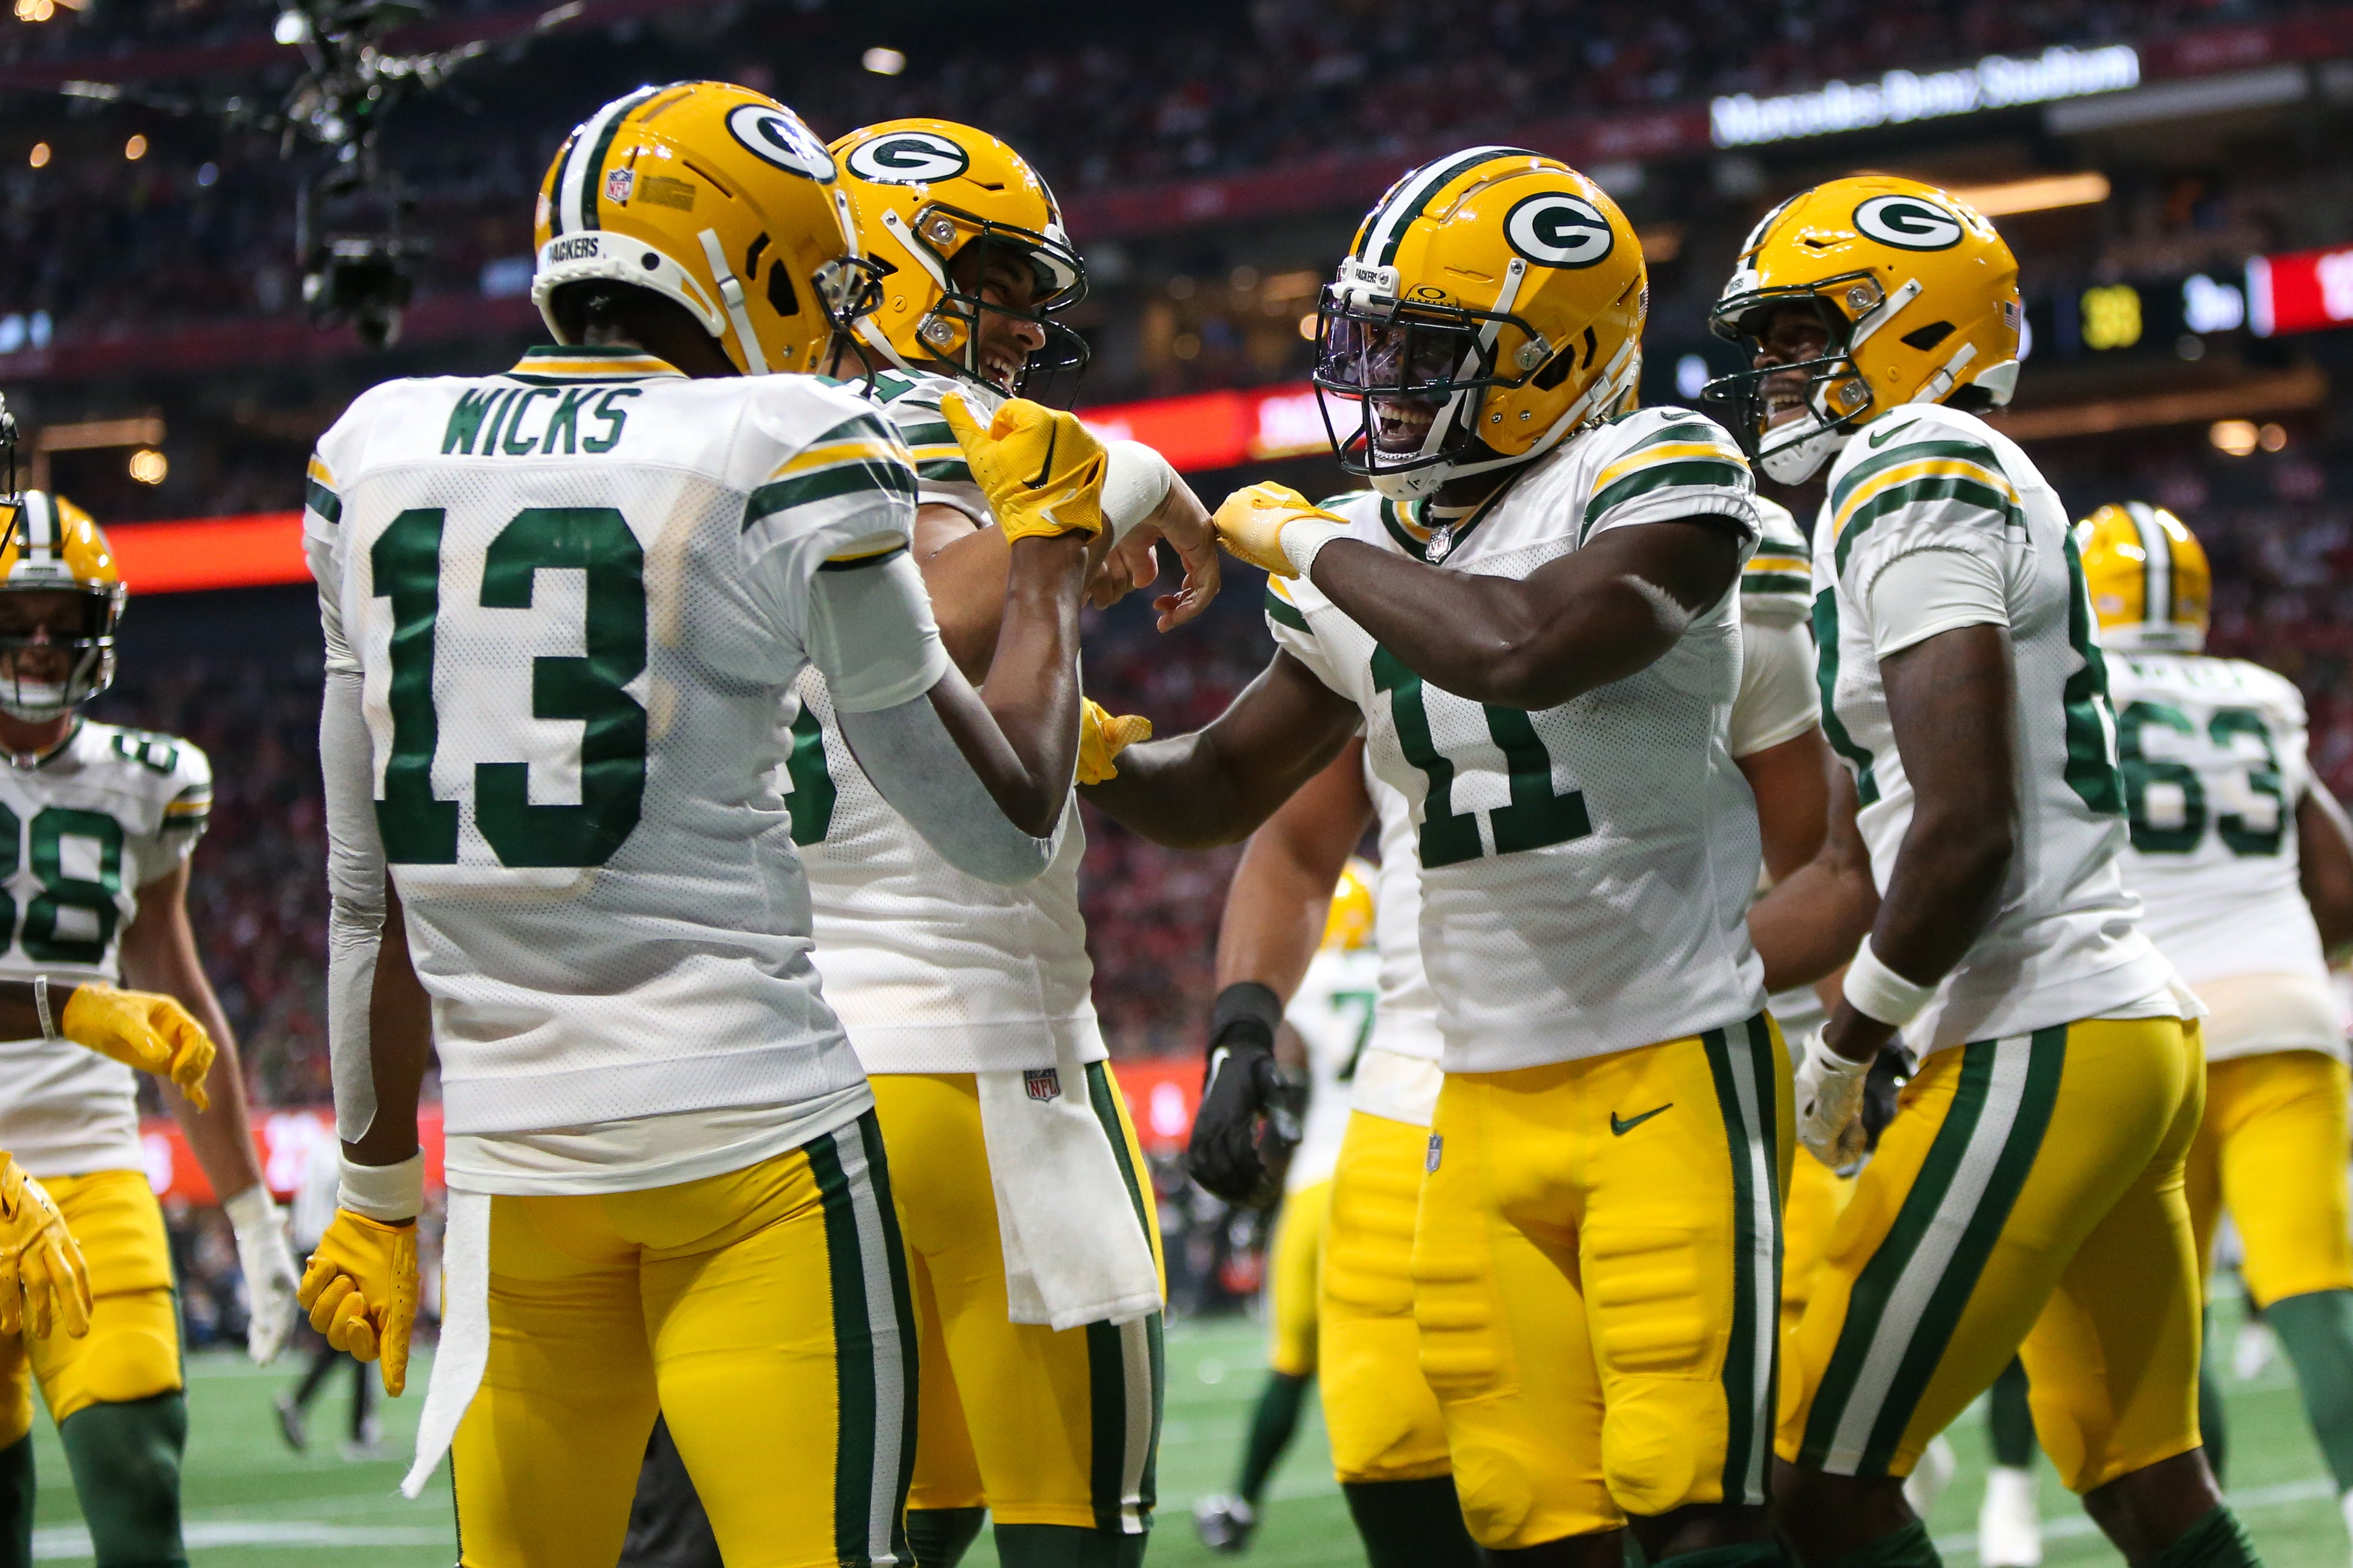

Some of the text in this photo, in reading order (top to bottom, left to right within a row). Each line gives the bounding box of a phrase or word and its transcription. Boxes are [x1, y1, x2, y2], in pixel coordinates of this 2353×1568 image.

[850, 132, 963, 180] G
[547, 237, 598, 266] PACKERS
[1509, 196, 1610, 262] G
[1856, 197, 1961, 246] G
[1355, 268, 1378, 284] PACKERS
[441, 387, 642, 456] WICKS
[371, 507, 648, 869] 13
[1369, 643, 1593, 869] 11
[2115, 701, 2287, 857] 63
[0, 800, 124, 966] 8
[1029, 1078, 1058, 1098] NFL
